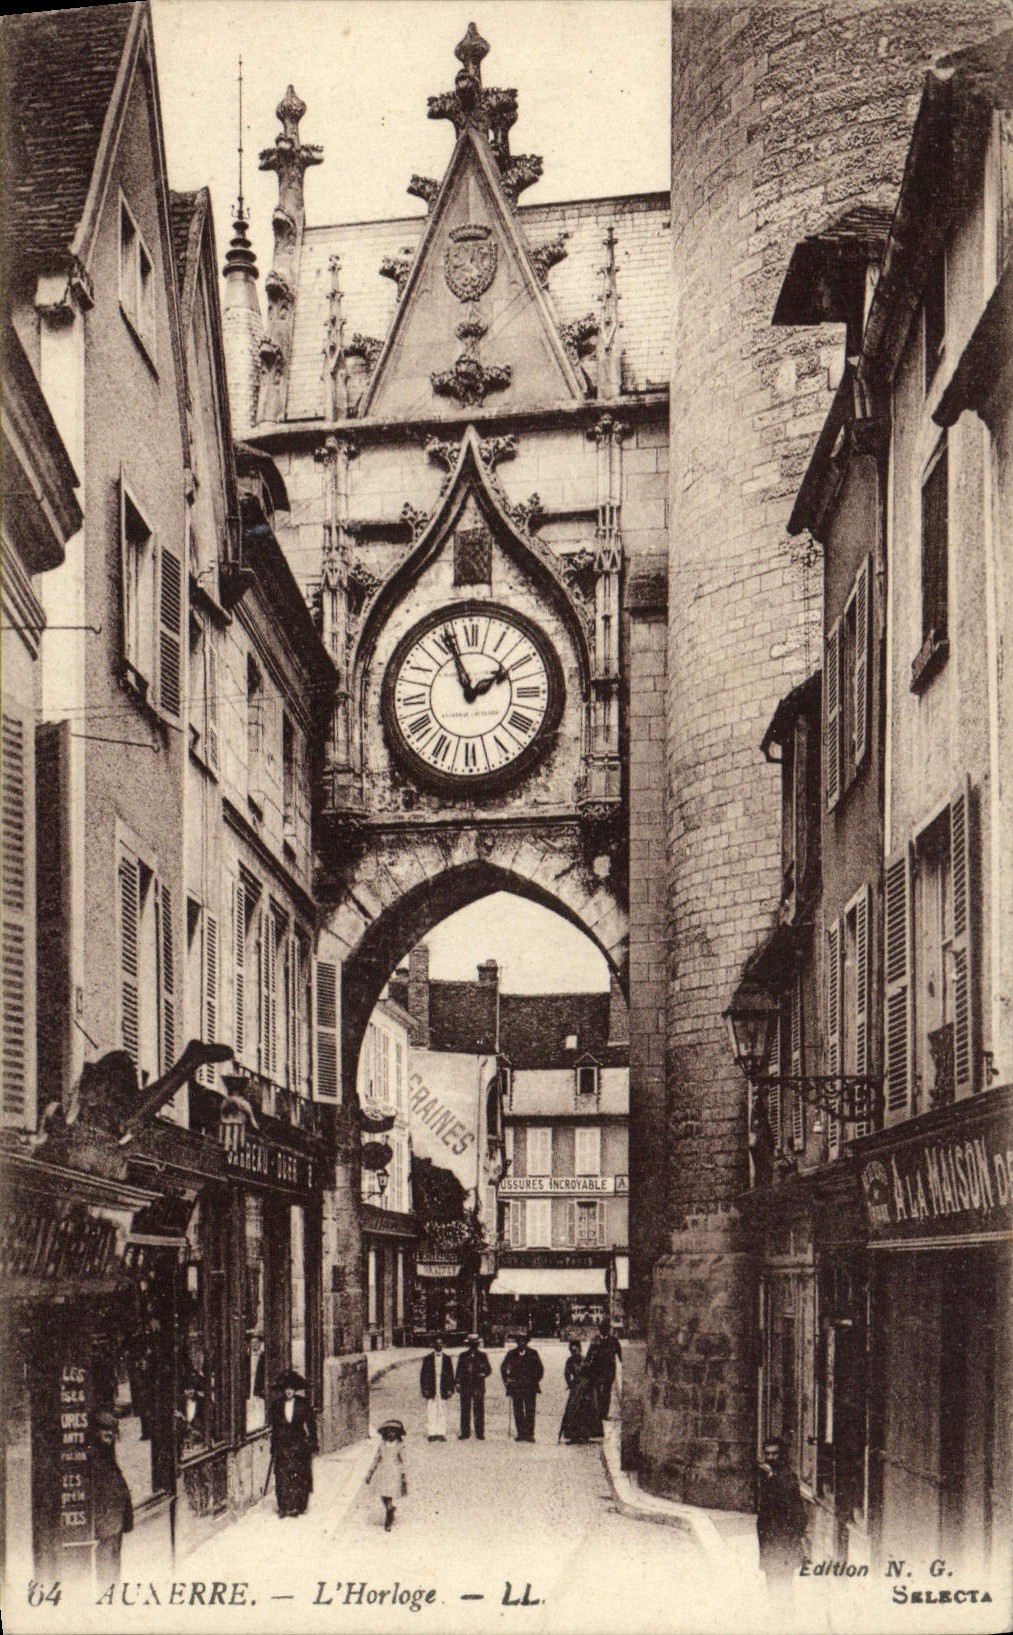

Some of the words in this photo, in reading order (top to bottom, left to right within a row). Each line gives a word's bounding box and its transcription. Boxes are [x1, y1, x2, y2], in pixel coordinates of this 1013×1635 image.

[516, 686, 540, 698] III
[549, 1178, 607, 1190] INCROYABLE
[890, 1153, 908, 1222] A
[906, 1170, 929, 1219] LA
[925, 1135, 994, 1217] MAISON
